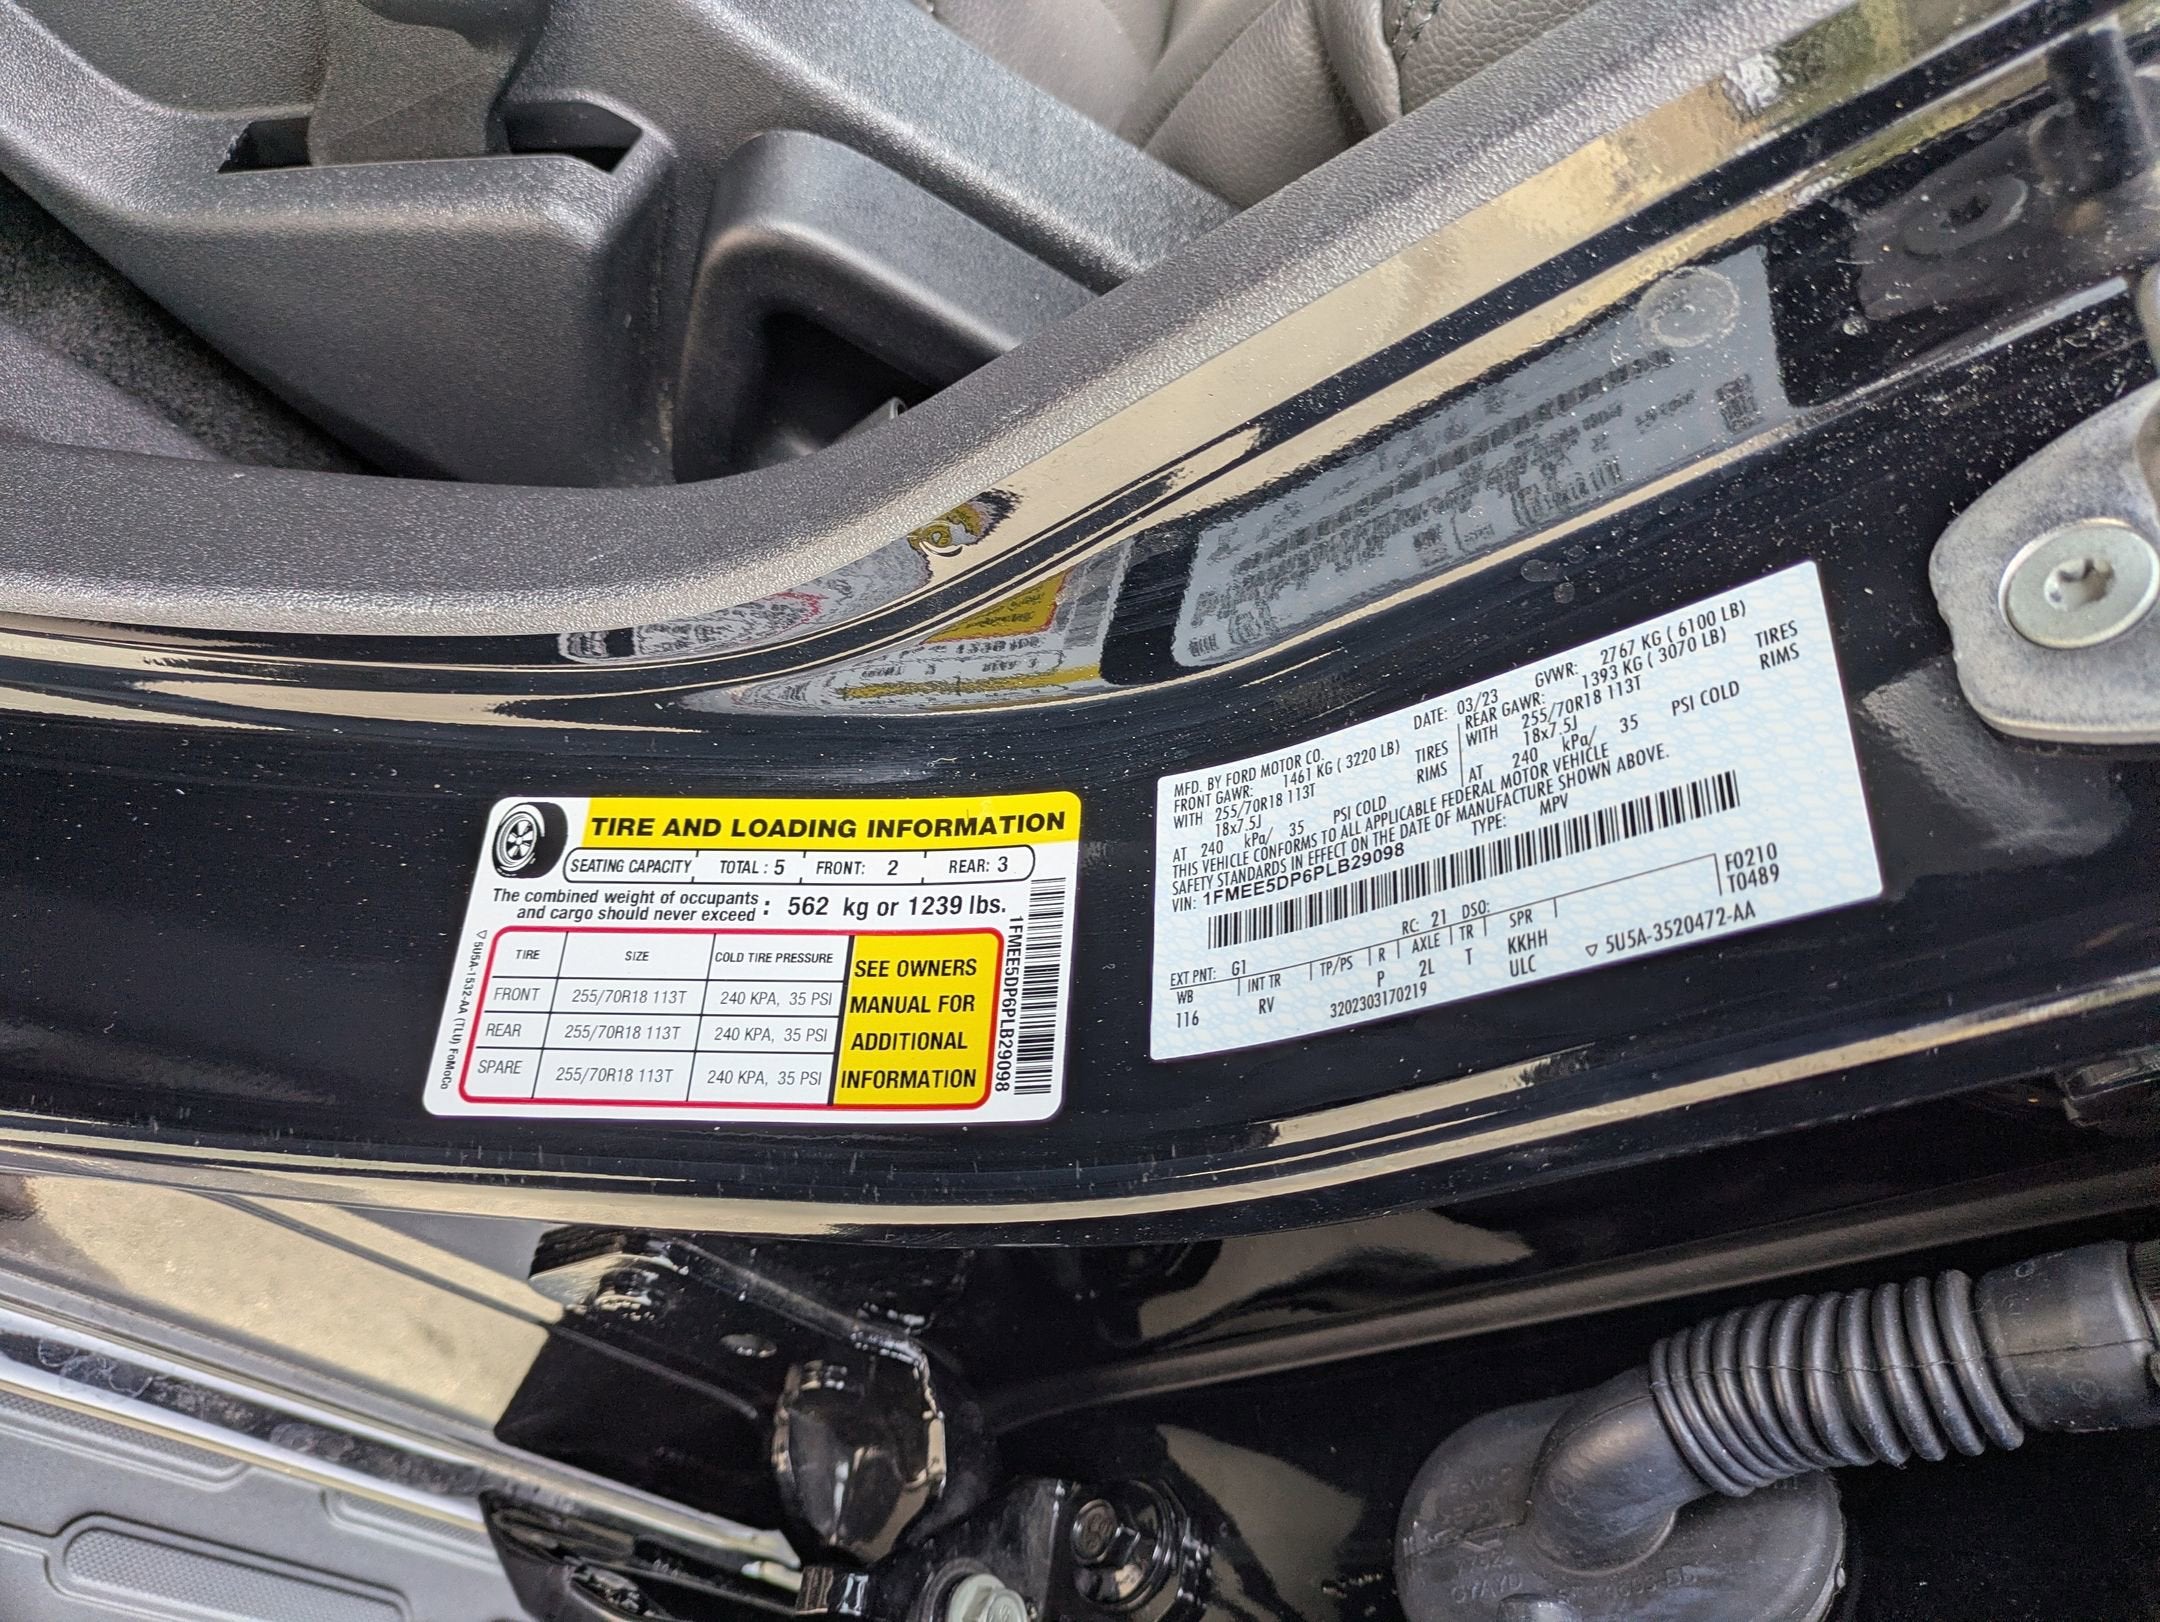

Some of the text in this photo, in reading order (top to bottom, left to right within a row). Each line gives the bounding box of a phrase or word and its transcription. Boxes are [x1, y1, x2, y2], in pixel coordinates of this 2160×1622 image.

[1535, 600, 1746, 687] GVWR: 2767 KG 6100 LB)
[1755, 621, 1799, 648] TIRES
[1760, 643, 1800, 670] RIMS
[1465, 626, 1726, 729] REAR GAWR: 1393 KG 3070 LB)
[1414, 689, 1498, 730] DATE: 03/23
[1466, 676, 1641, 747] WITH 255/70R18 113T
[1468, 681, 1740, 783] AT 240 kPa/ 35 PSI COLD
[1524, 716, 1577, 746] 18x7.5J
[1415, 741, 1449, 764] TIRES
[1174, 749, 1324, 797] MFD. BY FORD MOTOR CO.
[1174, 739, 1400, 813] FRONT GAWR: 1461 KG 3220 LB)
[1416, 762, 1448, 784] RIMS
[1173, 743, 1609, 878] THIS VEHICLE CONFORMS TO ALL APPLICABLE FEDERAL MOTOR VEHICLE
[1174, 783, 1316, 829] WITH 255/70R18 113T
[1471, 794, 1569, 836] TYPE: MPV
[591, 811, 1066, 838] TIRE AND LOADING INFORMATION
[1172, 743, 1669, 896] SAFETY STANDARDS IN EFFECT ON THE DATE OF MANUFACTURE SHOWN ABOVE.
[1173, 796, 1387, 863] AT 240 kPa/ 35 PSI COLD
[1216, 815, 1262, 837] 18x7.5J
[570, 858, 692, 874] SEATING CAPACITY
[774, 860, 785, 875] 5
[816, 860, 898, 876] FRONT: 2
[949, 856, 1008, 874] REAR: 3
[1172, 842, 1405, 913] VIN: 1FMEE5DP6PLB29098
[493, 888, 758, 908] The combined weight of occupants
[788, 895, 1006, 920] 562 kg or 1239 lbs.
[517, 906, 756, 923] and cargo should never exceed
[1431, 908, 1448, 928] 21
[1509, 908, 1534, 928] SPR
[1605, 900, 1756, 954] 5U5A-3520472-AA
[1411, 933, 1441, 954] AXLE
[1507, 929, 1549, 955] KKHH
[516, 950, 540, 960] TIRE
[625, 951, 650, 962] SIZE
[715, 952, 833, 964] COLD TIRE PRESSURE
[854, 959, 976, 978] SEE OWNERS
[1170, 960, 1246, 986] EXT PNT: G1
[1320, 956, 1354, 977] TP/PS
[1510, 955, 1536, 977] ULC
[1248, 974, 1282, 992] INT TR
[494, 988, 540, 1000] FRONT
[572, 989, 688, 1004] 255/70R18 113T
[720, 992, 832, 1008] 240 KPA, 35 PSI
[850, 994, 975, 1013] MANUAL FOR
[994, 915, 1024, 1092] 1FMEE5DP6PLB29098
[1176, 990, 1194, 1004] WB
[1330, 982, 1428, 1018] 3202303170219
[1258, 997, 1275, 1014] RV
[1176, 1010, 1199, 1028] 116
[448, 1018, 466, 1044] (TLU)
[486, 1024, 522, 1036] REAR
[564, 1024, 682, 1040] 255/70R18 113T
[714, 1028, 828, 1043] 240 KPA, 35 PSI
[851, 1032, 968, 1050] ADDITIONAL
[440, 1048, 459, 1090] FoMoCo
[478, 1060, 522, 1074] SPARE
[556, 1068, 674, 1084] 255/70R18 113T
[707, 1070, 822, 1086] 240 KPA, 35 PSI
[841, 1069, 976, 1089] INFORMATION
